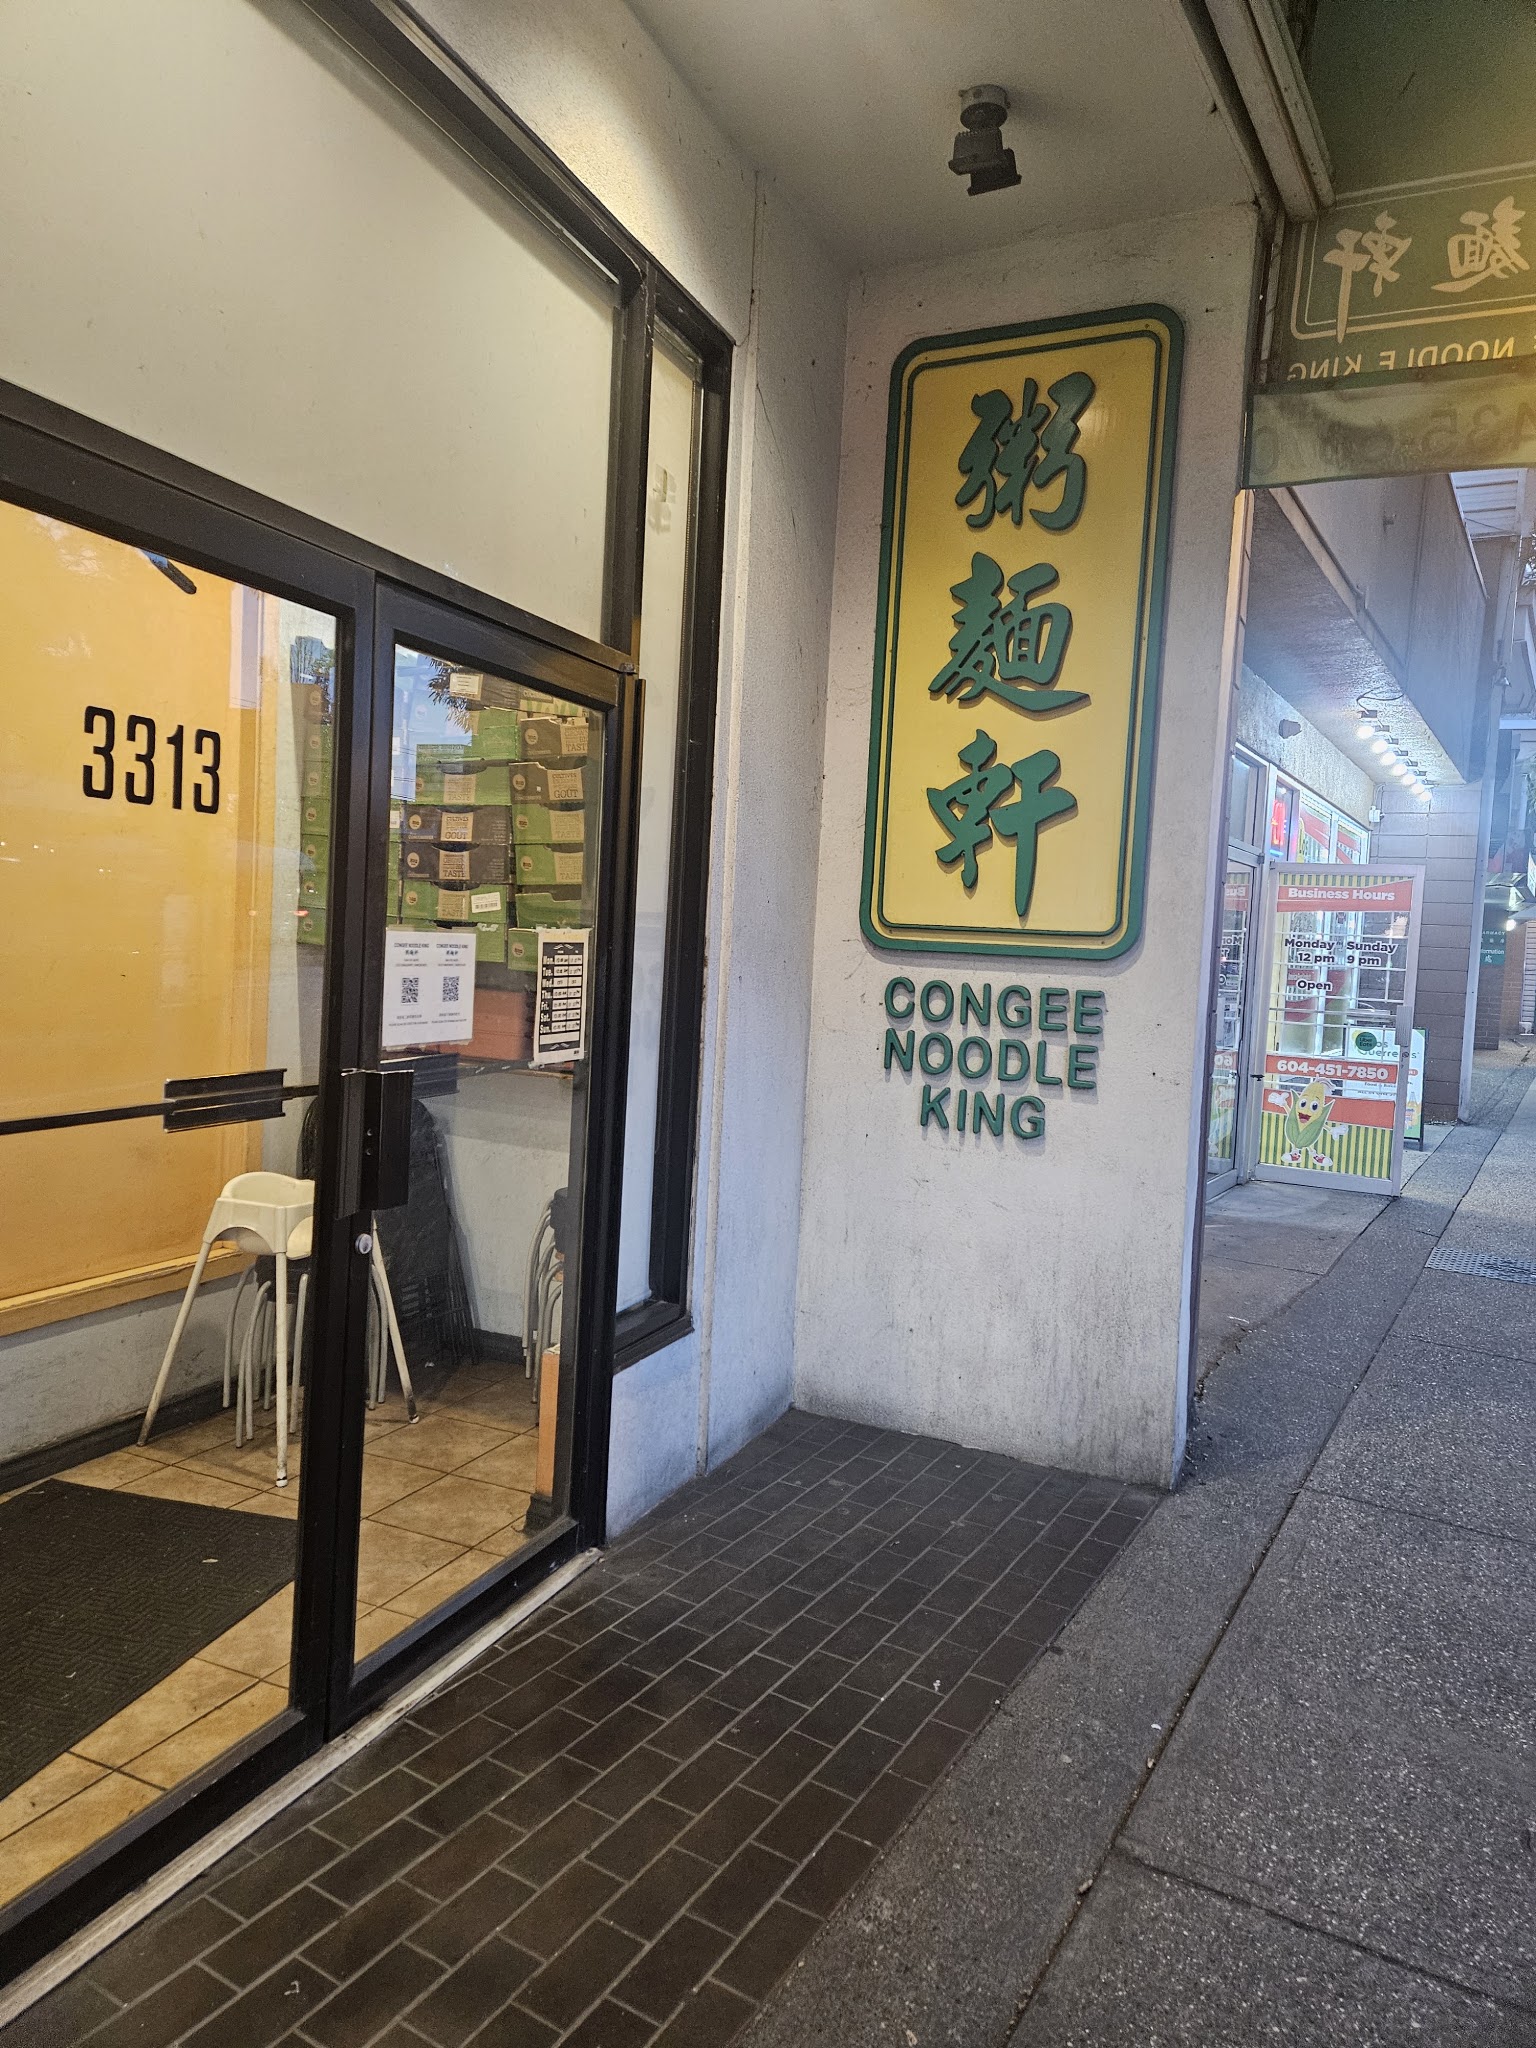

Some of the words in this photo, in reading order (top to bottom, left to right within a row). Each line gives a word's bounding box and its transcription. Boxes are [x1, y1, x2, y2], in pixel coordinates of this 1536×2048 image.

[82, 705, 221, 815] 3313
[1288, 887, 1350, 900] Business
[1352, 889, 1396, 901] Hours
[1284, 939, 1336, 951] Monday
[1346, 941, 1397, 954] Sunday
[1298, 952, 1311, 962] 12
[1314, 954, 1336, 964] pm
[1346, 955, 1355, 965] 9
[1358, 957, 1381, 967] pm
[1297, 980, 1332, 991] Open
[884, 976, 1105, 1034] CONGEE
[884, 1028, 1099, 1089] NOODLE
[1277, 1059, 1389, 1080] 604-451-7850
[920, 1084, 1046, 1139] KING
